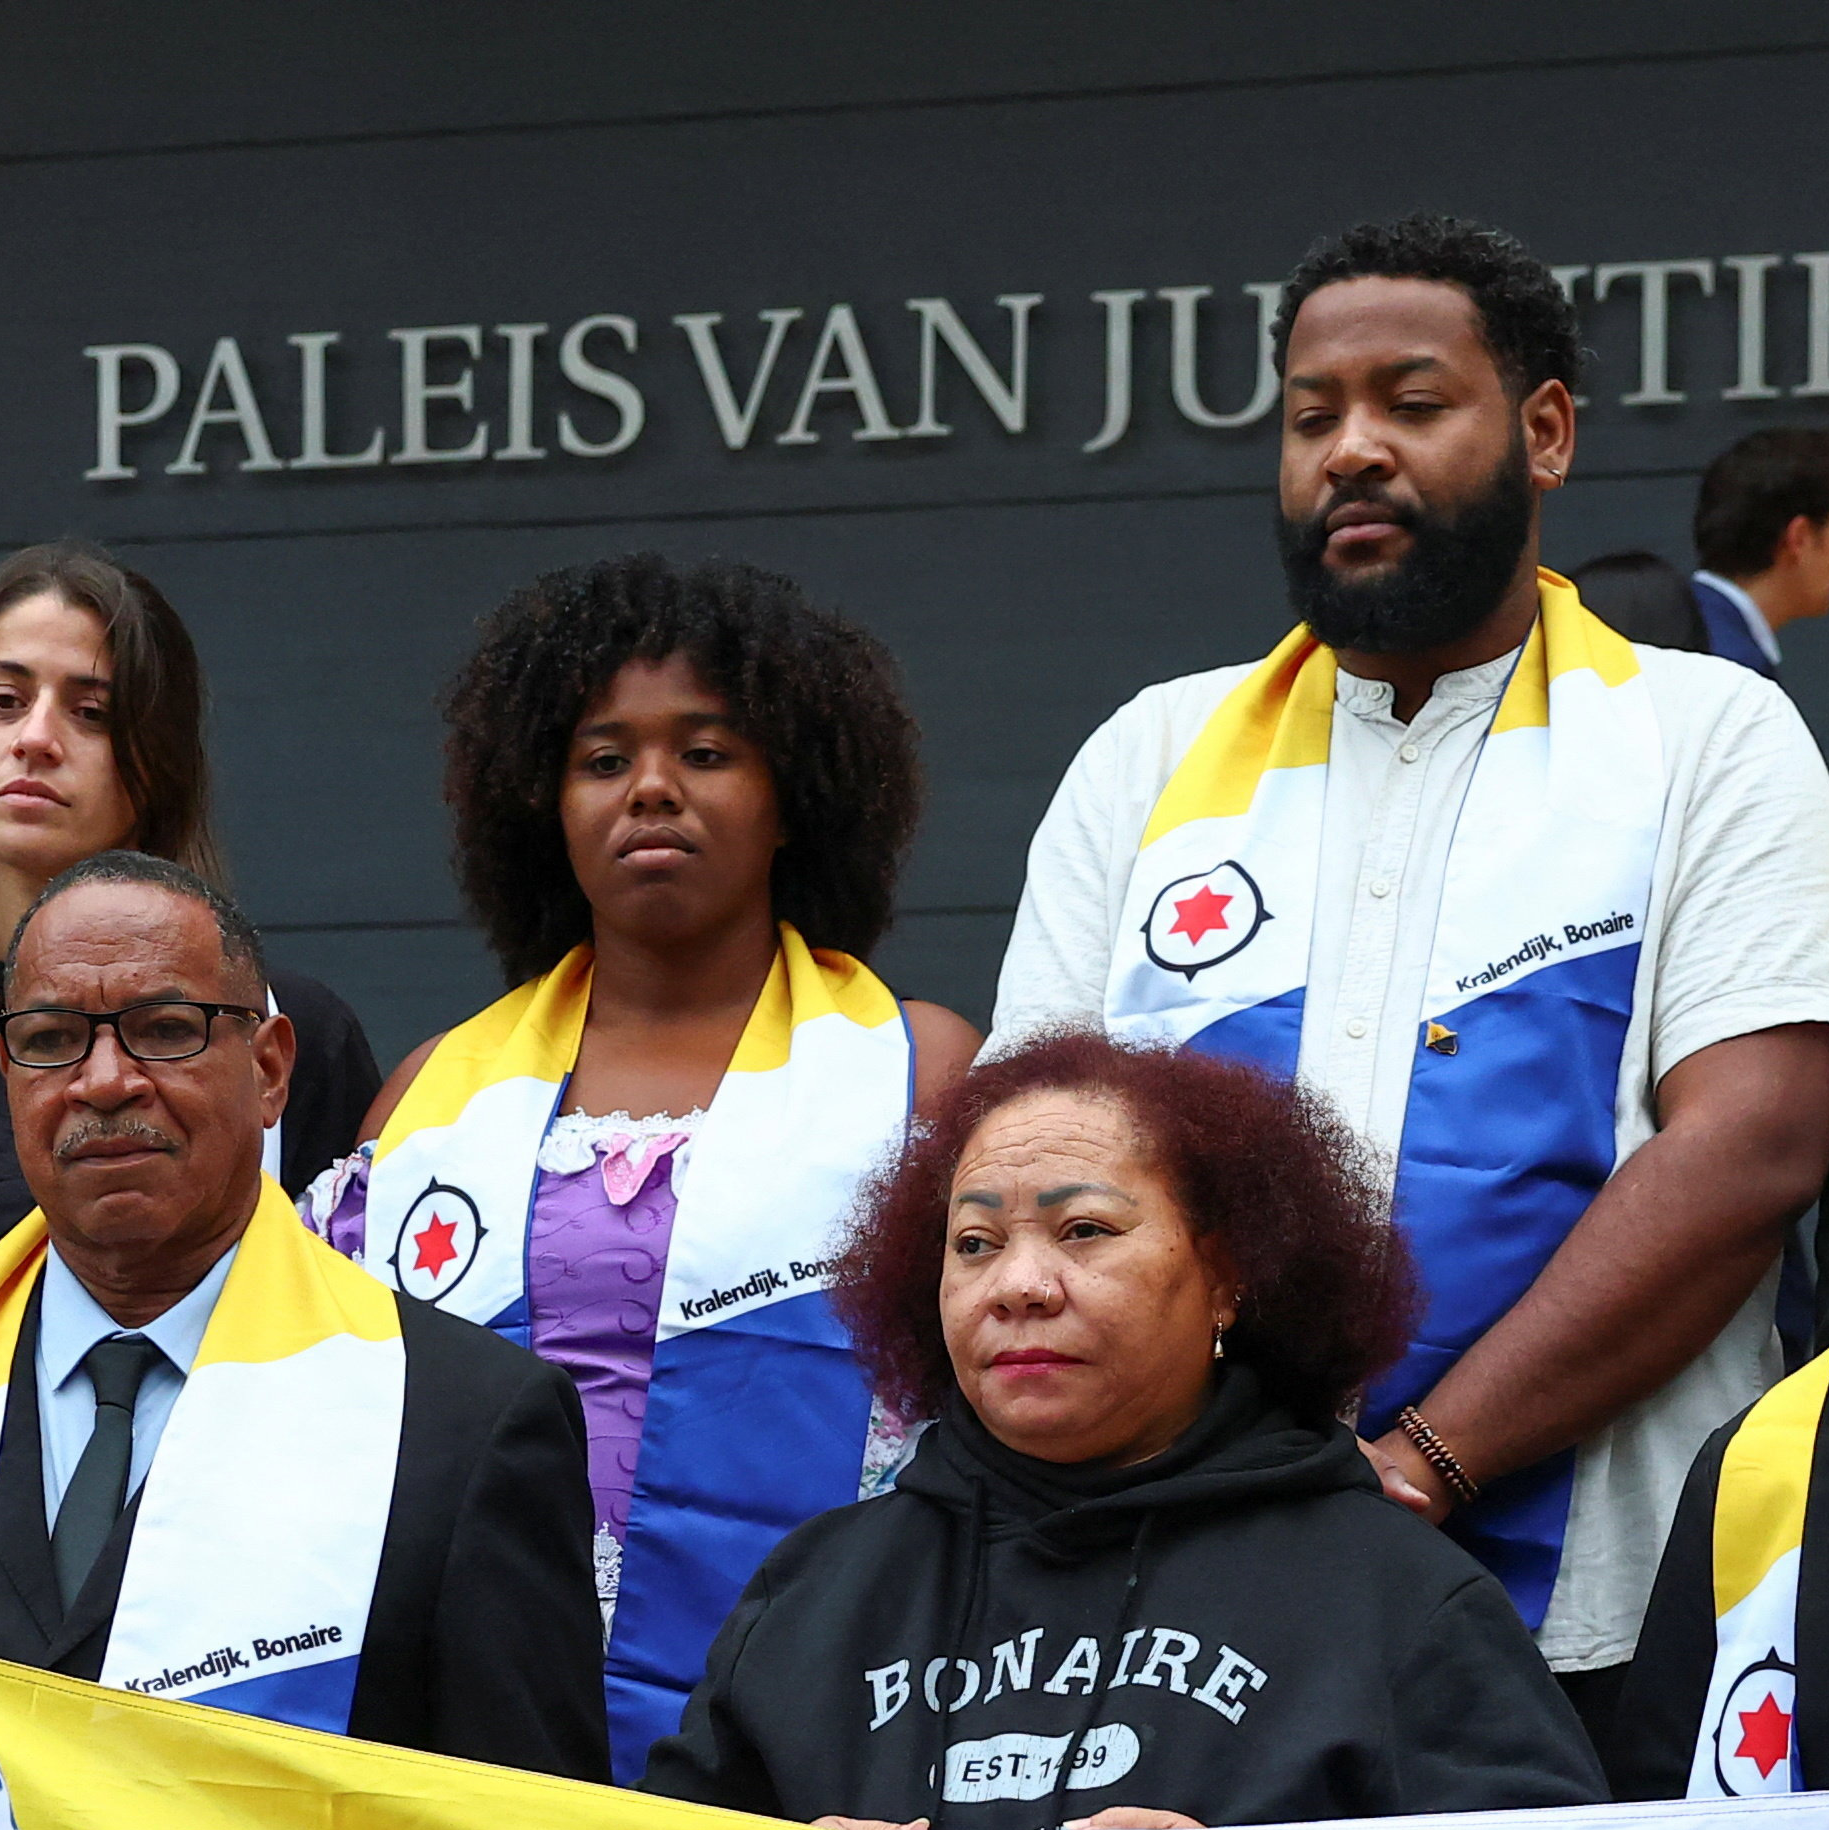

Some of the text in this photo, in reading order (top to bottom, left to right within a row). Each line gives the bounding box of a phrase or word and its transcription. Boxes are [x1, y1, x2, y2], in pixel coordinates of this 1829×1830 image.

[84, 314, 646, 481] PALEIS
[672, 294, 1045, 450] VAN
[1456, 911, 1635, 993] Kralendijk, Bonaire
[680, 1270, 788, 1320] Kralendijk,
[125, 1624, 342, 1693] Kralendijk, Bonaire
[864, 1626, 1269, 1732] BONAIRE
[961, 1753, 1031, 1783] EST.
